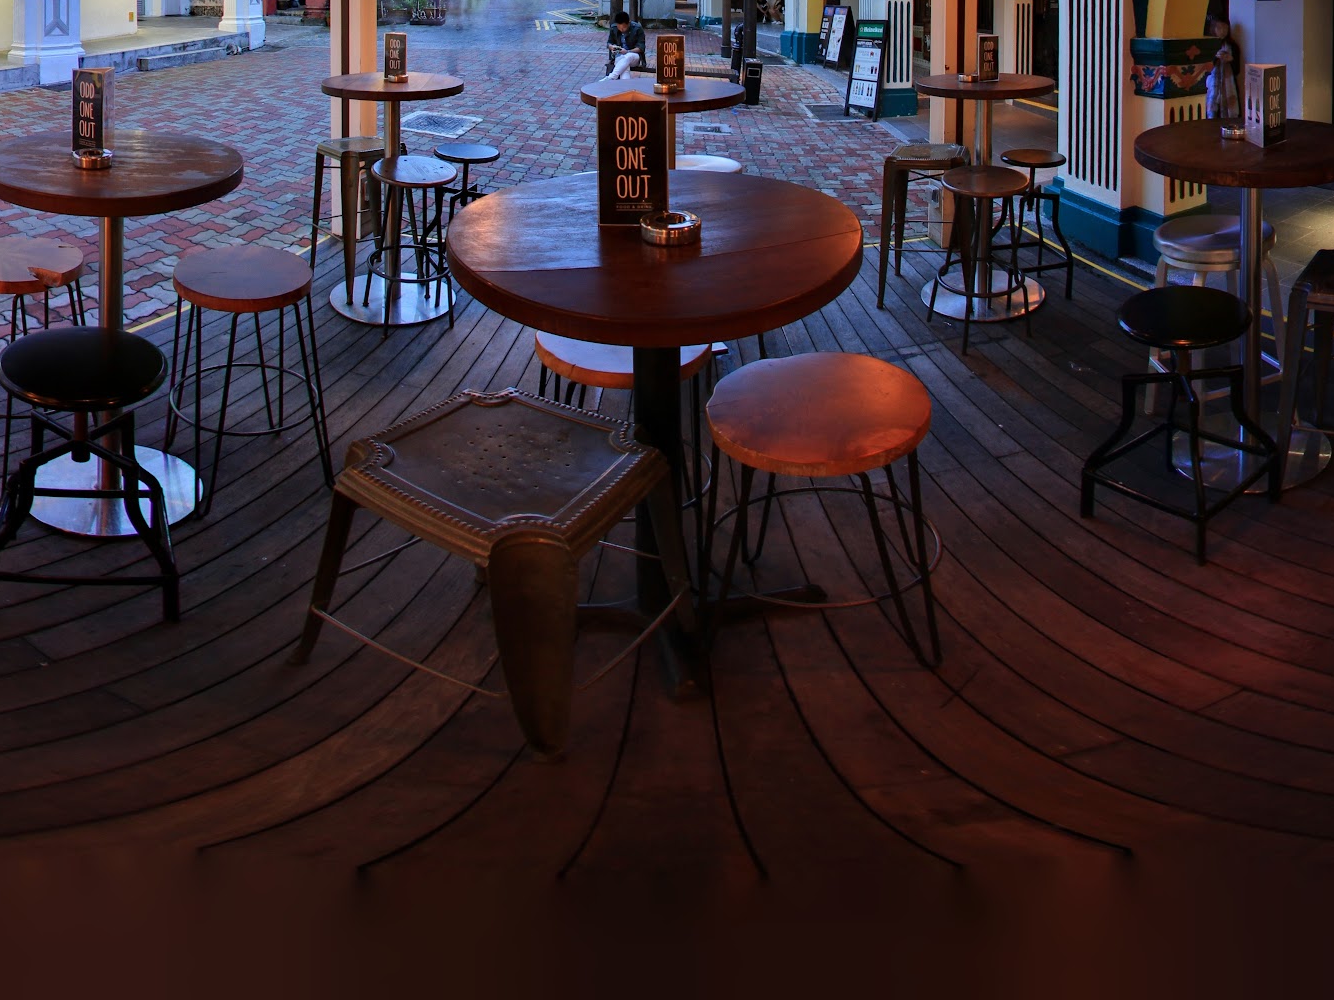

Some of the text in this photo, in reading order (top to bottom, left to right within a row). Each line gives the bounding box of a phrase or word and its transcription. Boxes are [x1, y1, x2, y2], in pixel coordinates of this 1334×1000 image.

[389, 39, 401, 49] ODD
[663, 42, 677, 53] ODD
[389, 49, 400, 59] ONE
[663, 54, 677, 65] ONE
[389, 60, 401, 70] OUT
[663, 66, 678, 78] OUT
[79, 81, 95, 99] ODD
[1269, 76, 1281, 92] ODD
[79, 101, 95, 119] ONE
[1269, 94, 1281, 110] ONE
[1269, 111, 1281, 128] OUT
[79, 120, 96, 139] OUT
[615, 115, 648, 141] ODD
[616, 145, 648, 171] ONE
[616, 174, 651, 199] OUT
